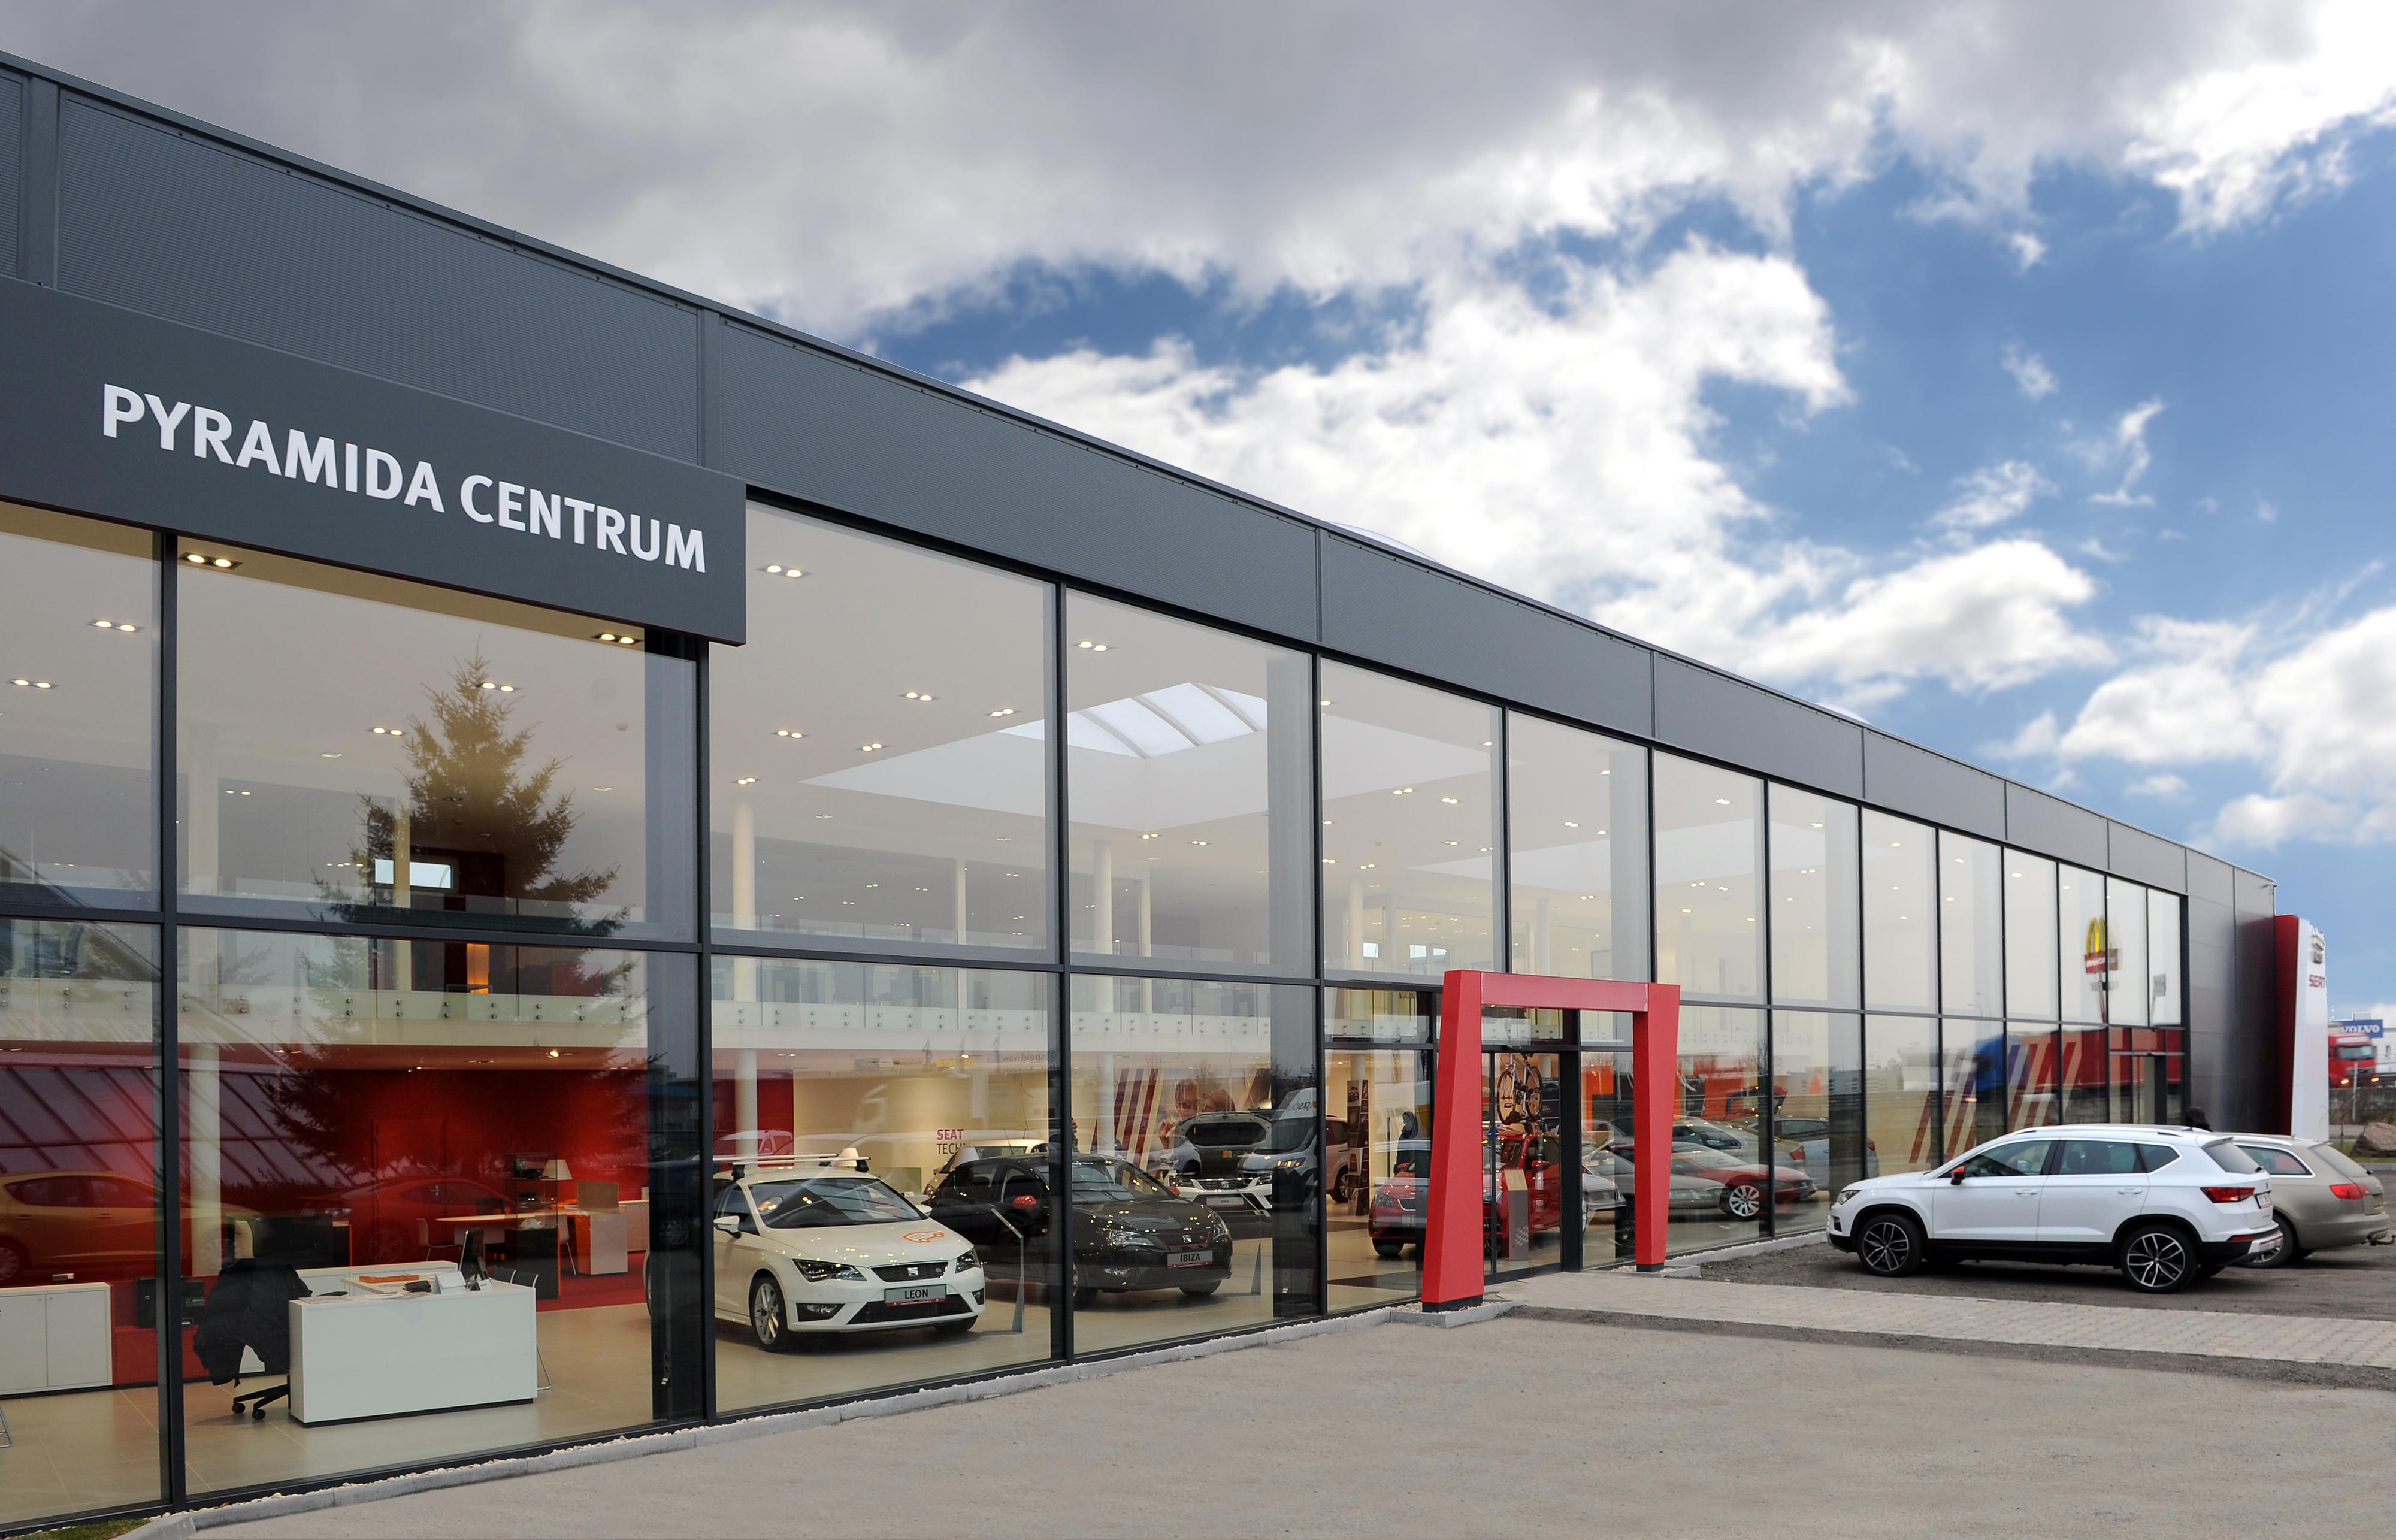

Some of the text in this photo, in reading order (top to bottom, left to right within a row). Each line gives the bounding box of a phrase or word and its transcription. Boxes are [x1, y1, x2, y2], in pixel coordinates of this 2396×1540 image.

[103, 383, 706, 573] PYRAMIDA CENTRUM
[2309, 975, 2326, 988] SEAT
[2341, 1024, 2380, 1034] VOLVO
[937, 1129, 964, 1140] SEAT
[1180, 1253, 1201, 1263] IBIZA
[904, 1288, 929, 1300] LEON
